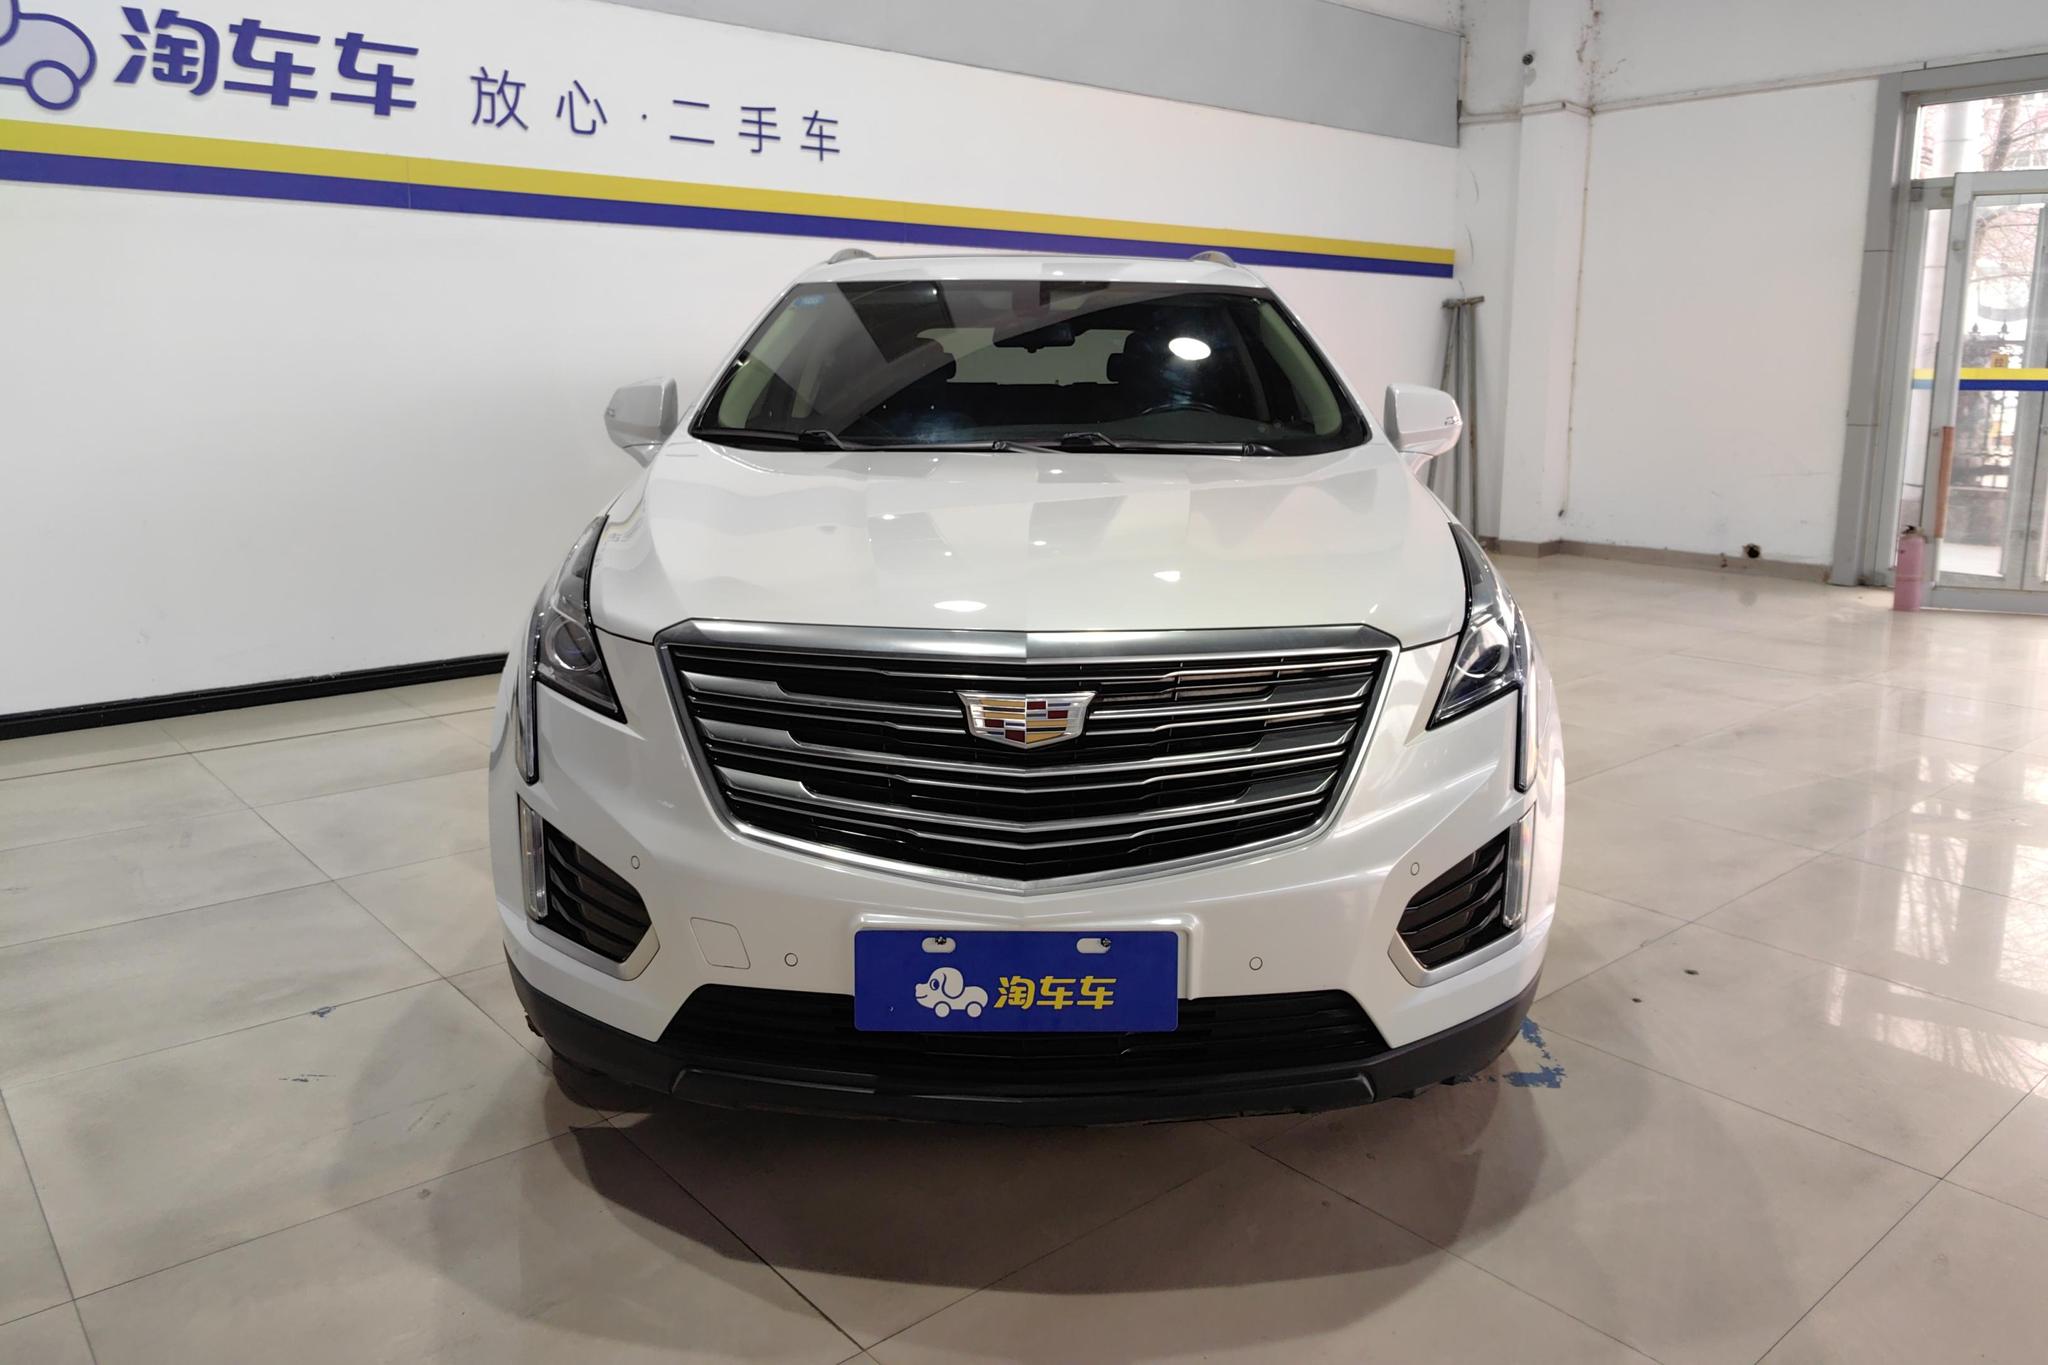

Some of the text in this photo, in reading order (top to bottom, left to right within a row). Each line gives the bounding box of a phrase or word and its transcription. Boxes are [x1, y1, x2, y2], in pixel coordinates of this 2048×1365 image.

[114, 6, 419, 116] 淘车车
[993, 975, 1117, 1009] 淘车车
